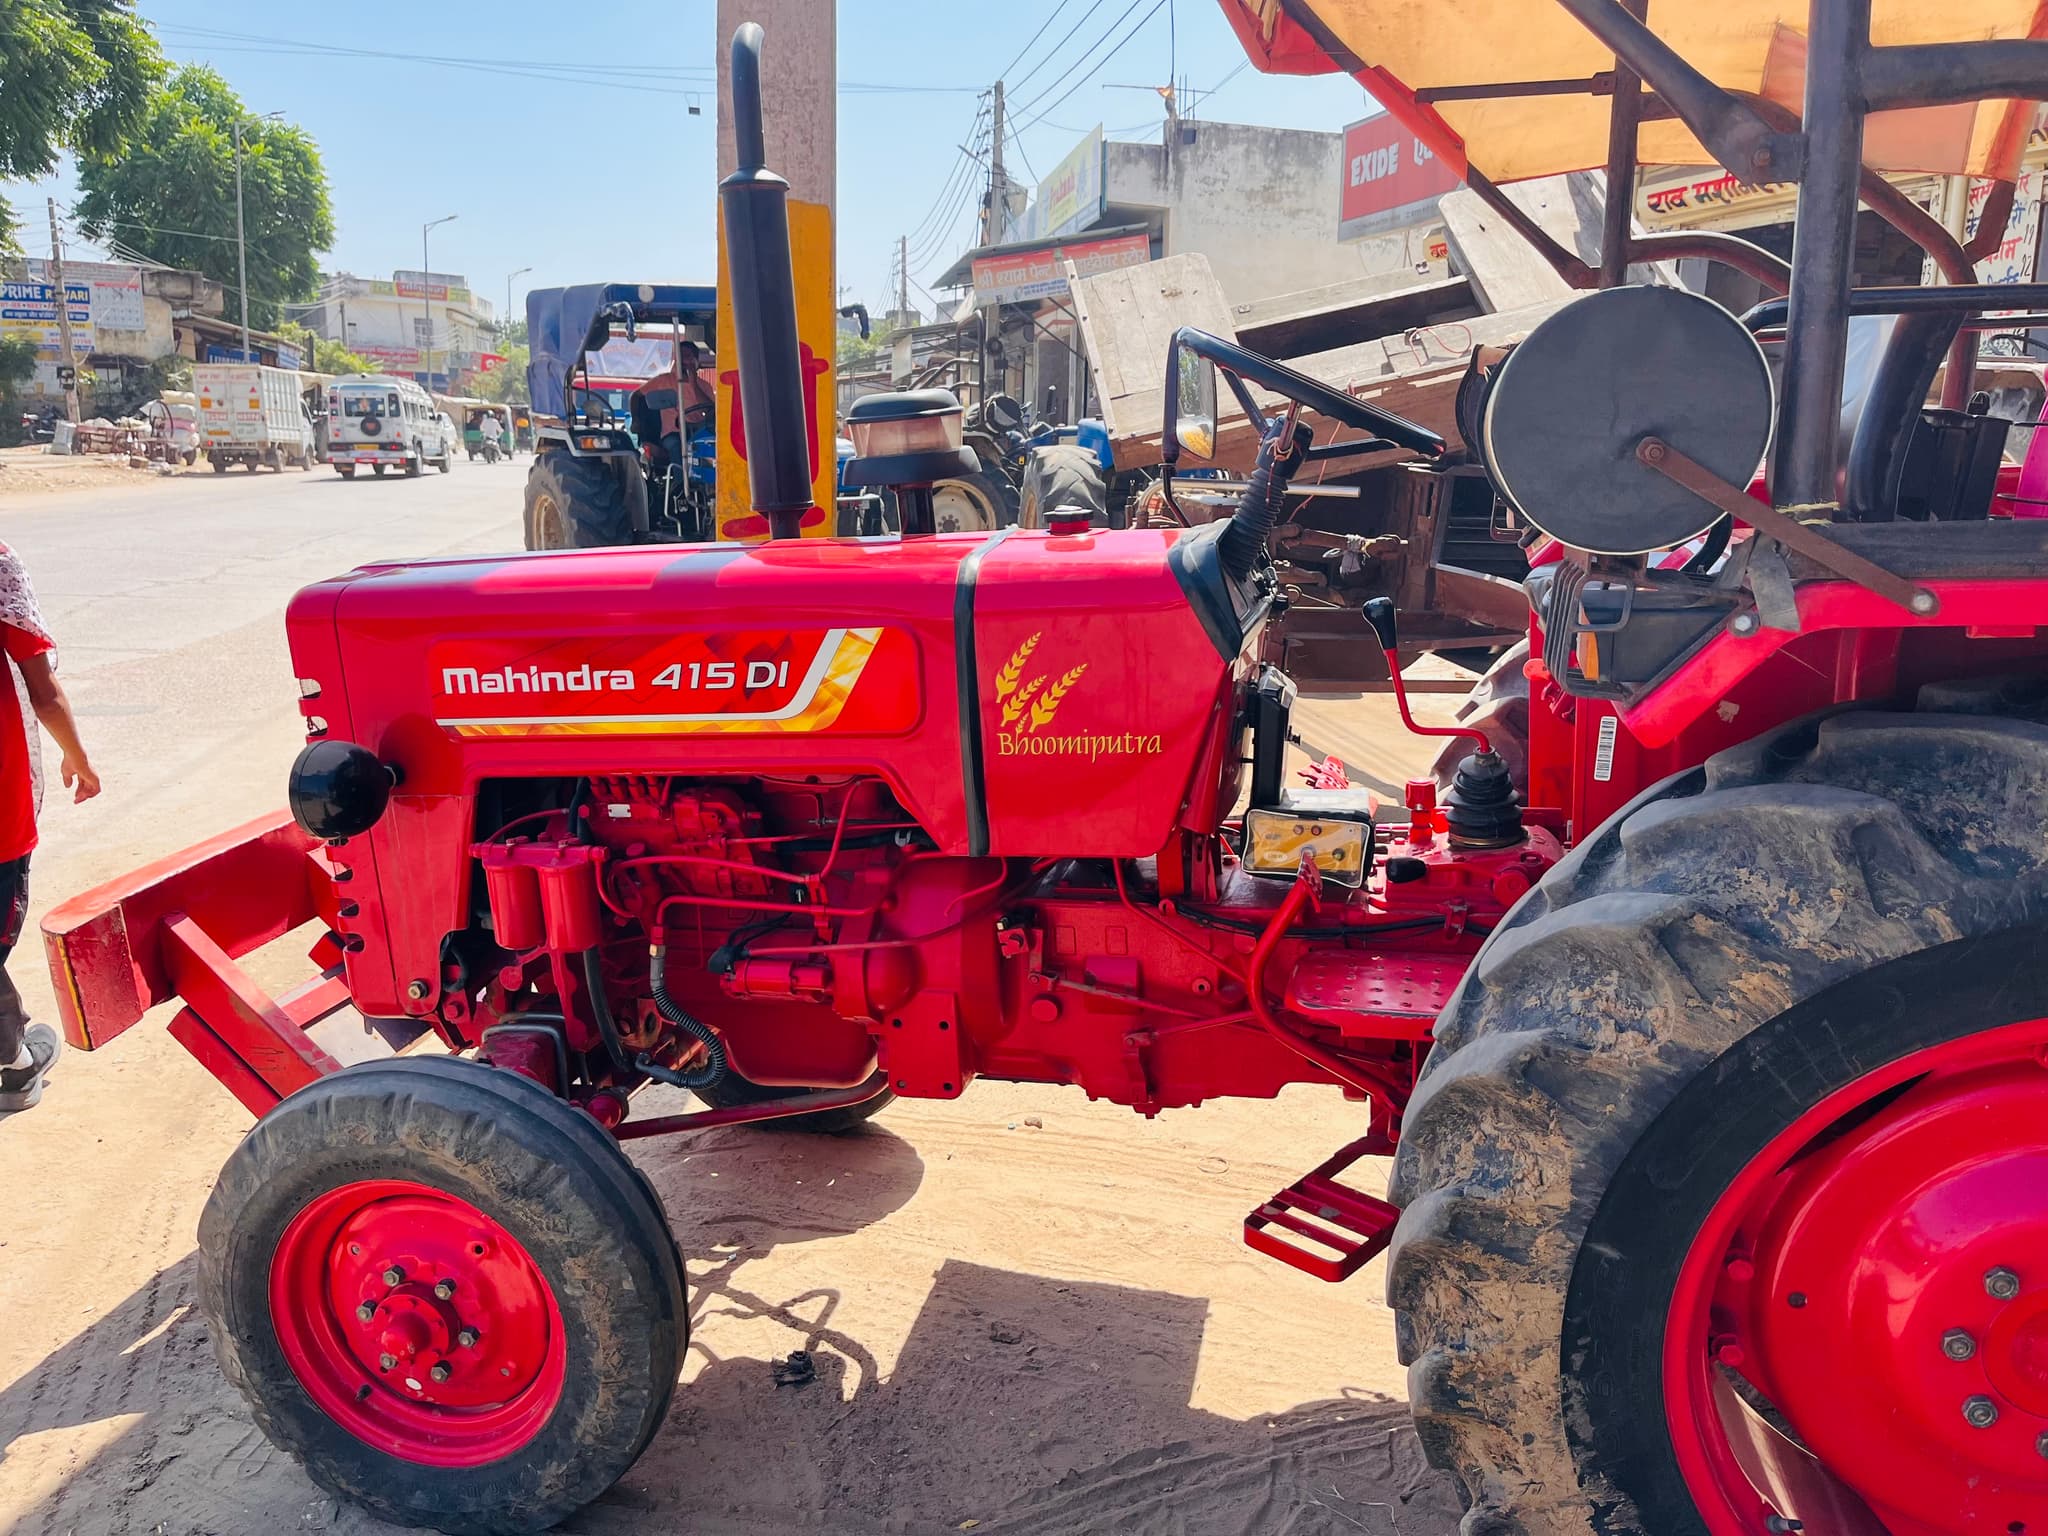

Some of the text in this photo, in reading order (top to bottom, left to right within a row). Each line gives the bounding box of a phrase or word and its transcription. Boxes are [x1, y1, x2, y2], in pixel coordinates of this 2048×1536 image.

[1351, 142, 1399, 187] EXIDE
[0, 284, 41, 300] PRIME
[441, 660, 790, 695] Mahindra 415 DI
[996, 728, 1163, 764] Bhoomiputra
